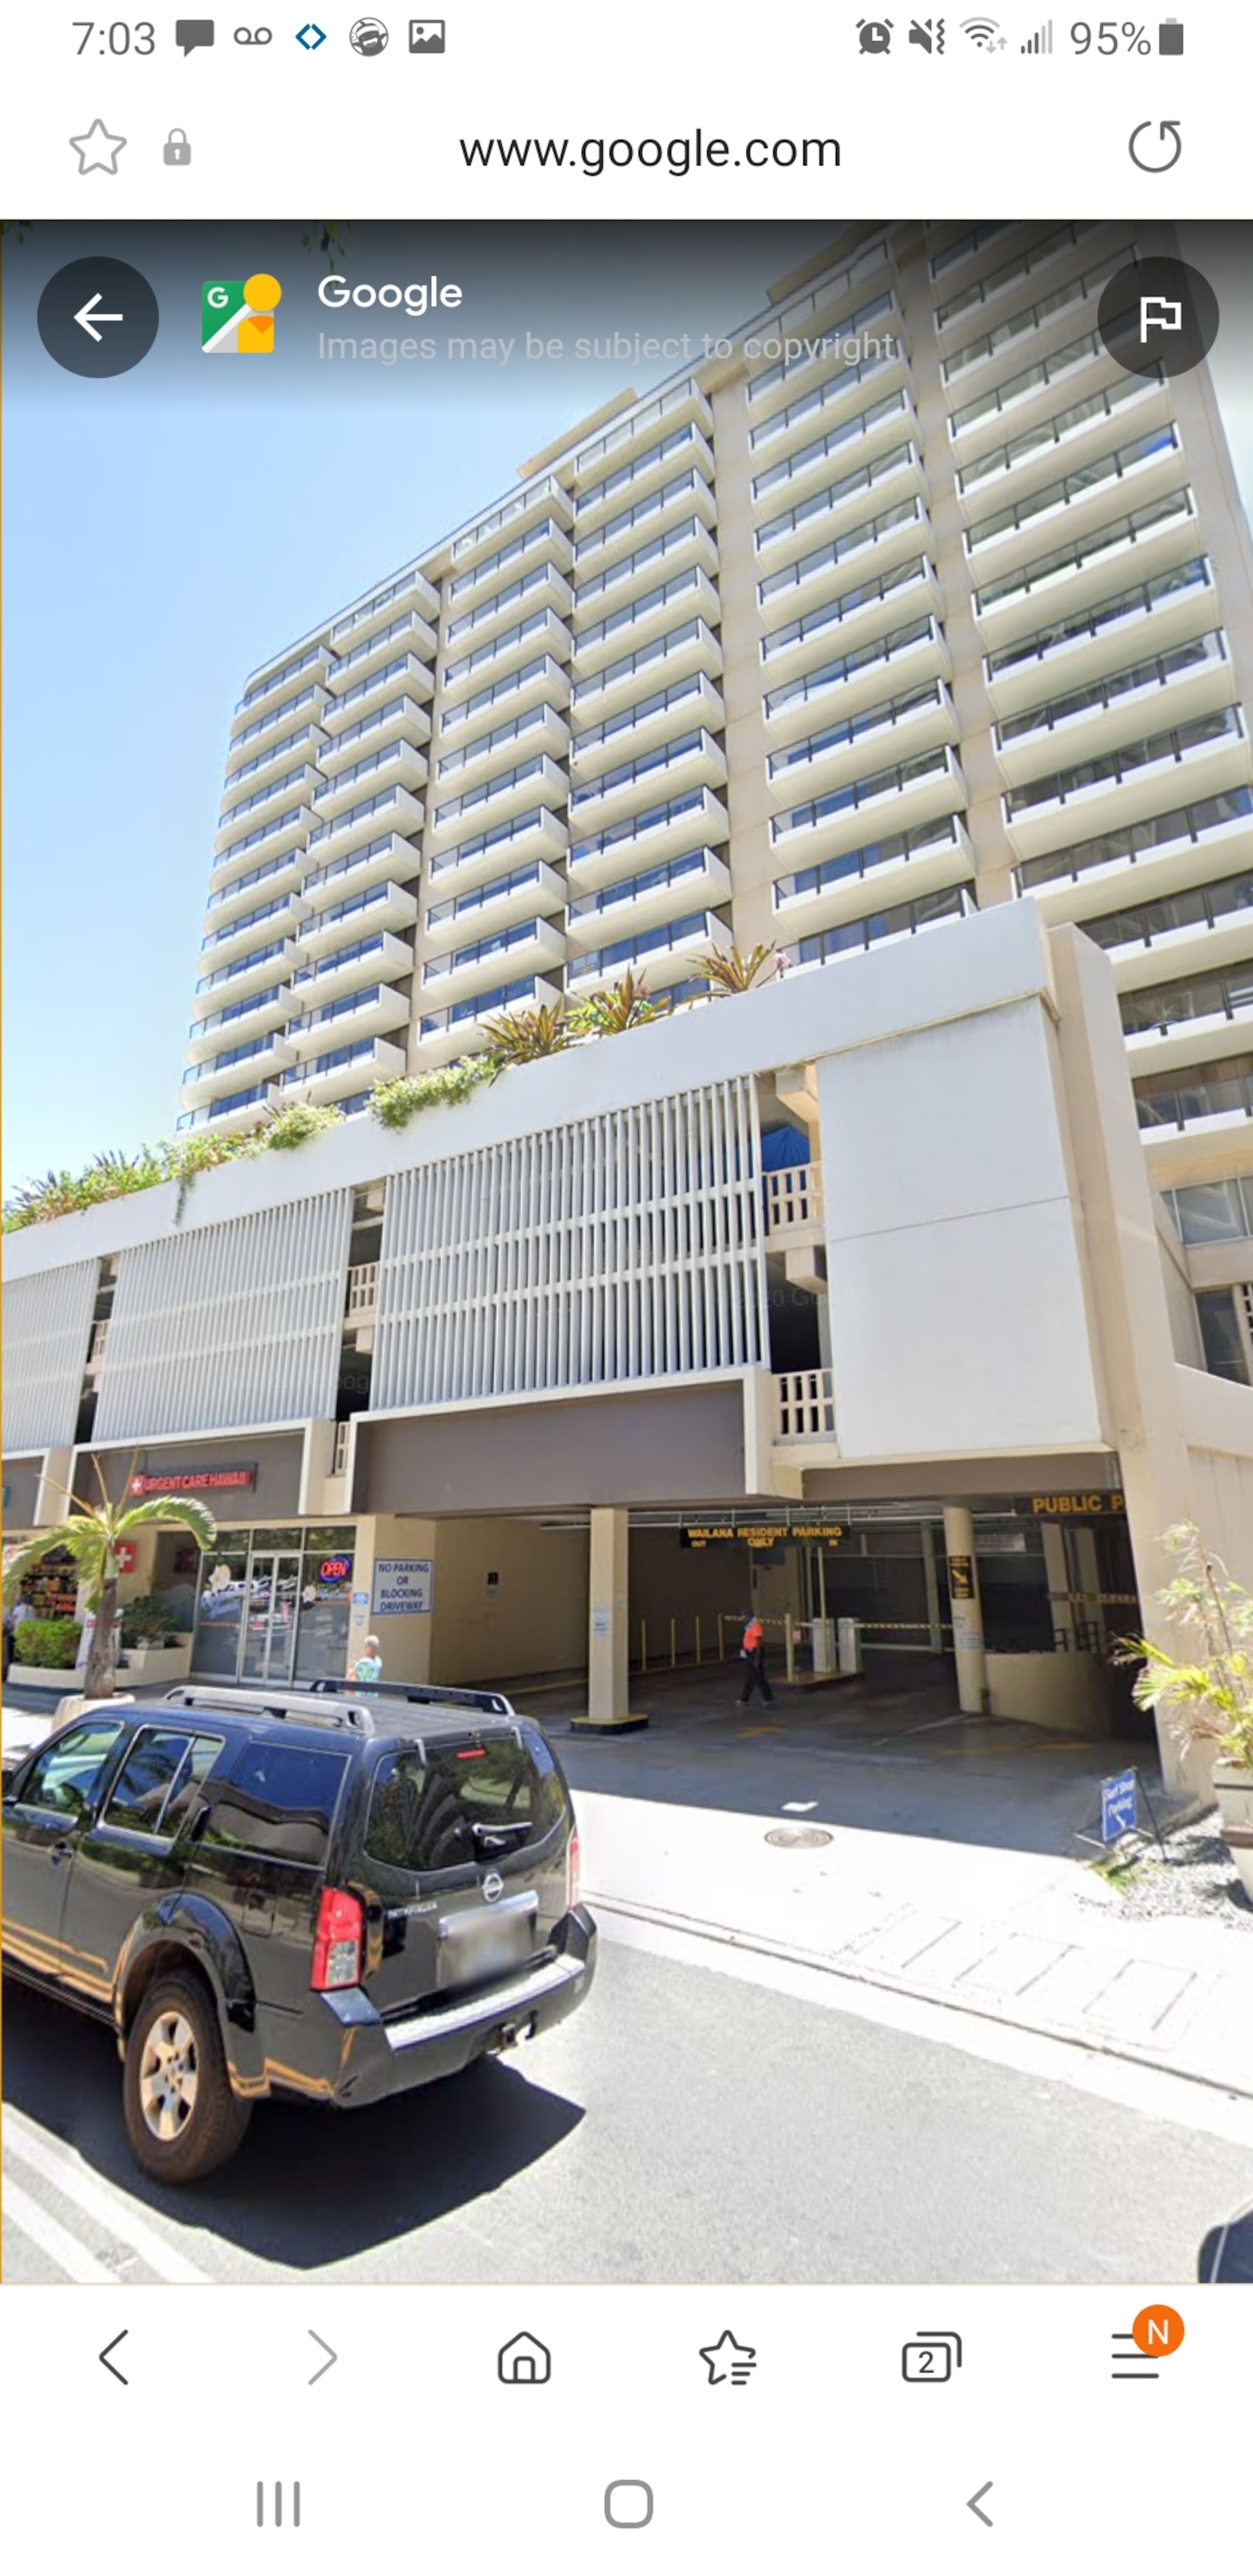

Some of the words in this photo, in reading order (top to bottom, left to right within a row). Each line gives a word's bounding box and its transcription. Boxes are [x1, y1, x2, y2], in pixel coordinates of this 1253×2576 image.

[146, 1475, 182, 1491] URGENT
[183, 1474, 209, 1488] CARE
[1033, 1494, 1102, 1513] PUBLIC
[688, 1528, 733, 1539] WAILANA
[737, 1527, 789, 1538] RESIDENT
[792, 1526, 842, 1537] PARKING
[747, 1537, 775, 1547] ONLY
[321, 1561, 347, 1577] OPEN
[378, 1563, 392, 1572] NO
[394, 1563, 429, 1572] PARKING
[396, 1576, 409, 1586] OR
[381, 1589, 422, 1599] BLOCKING
[380, 1601, 423, 1612] DRIVEWAY
